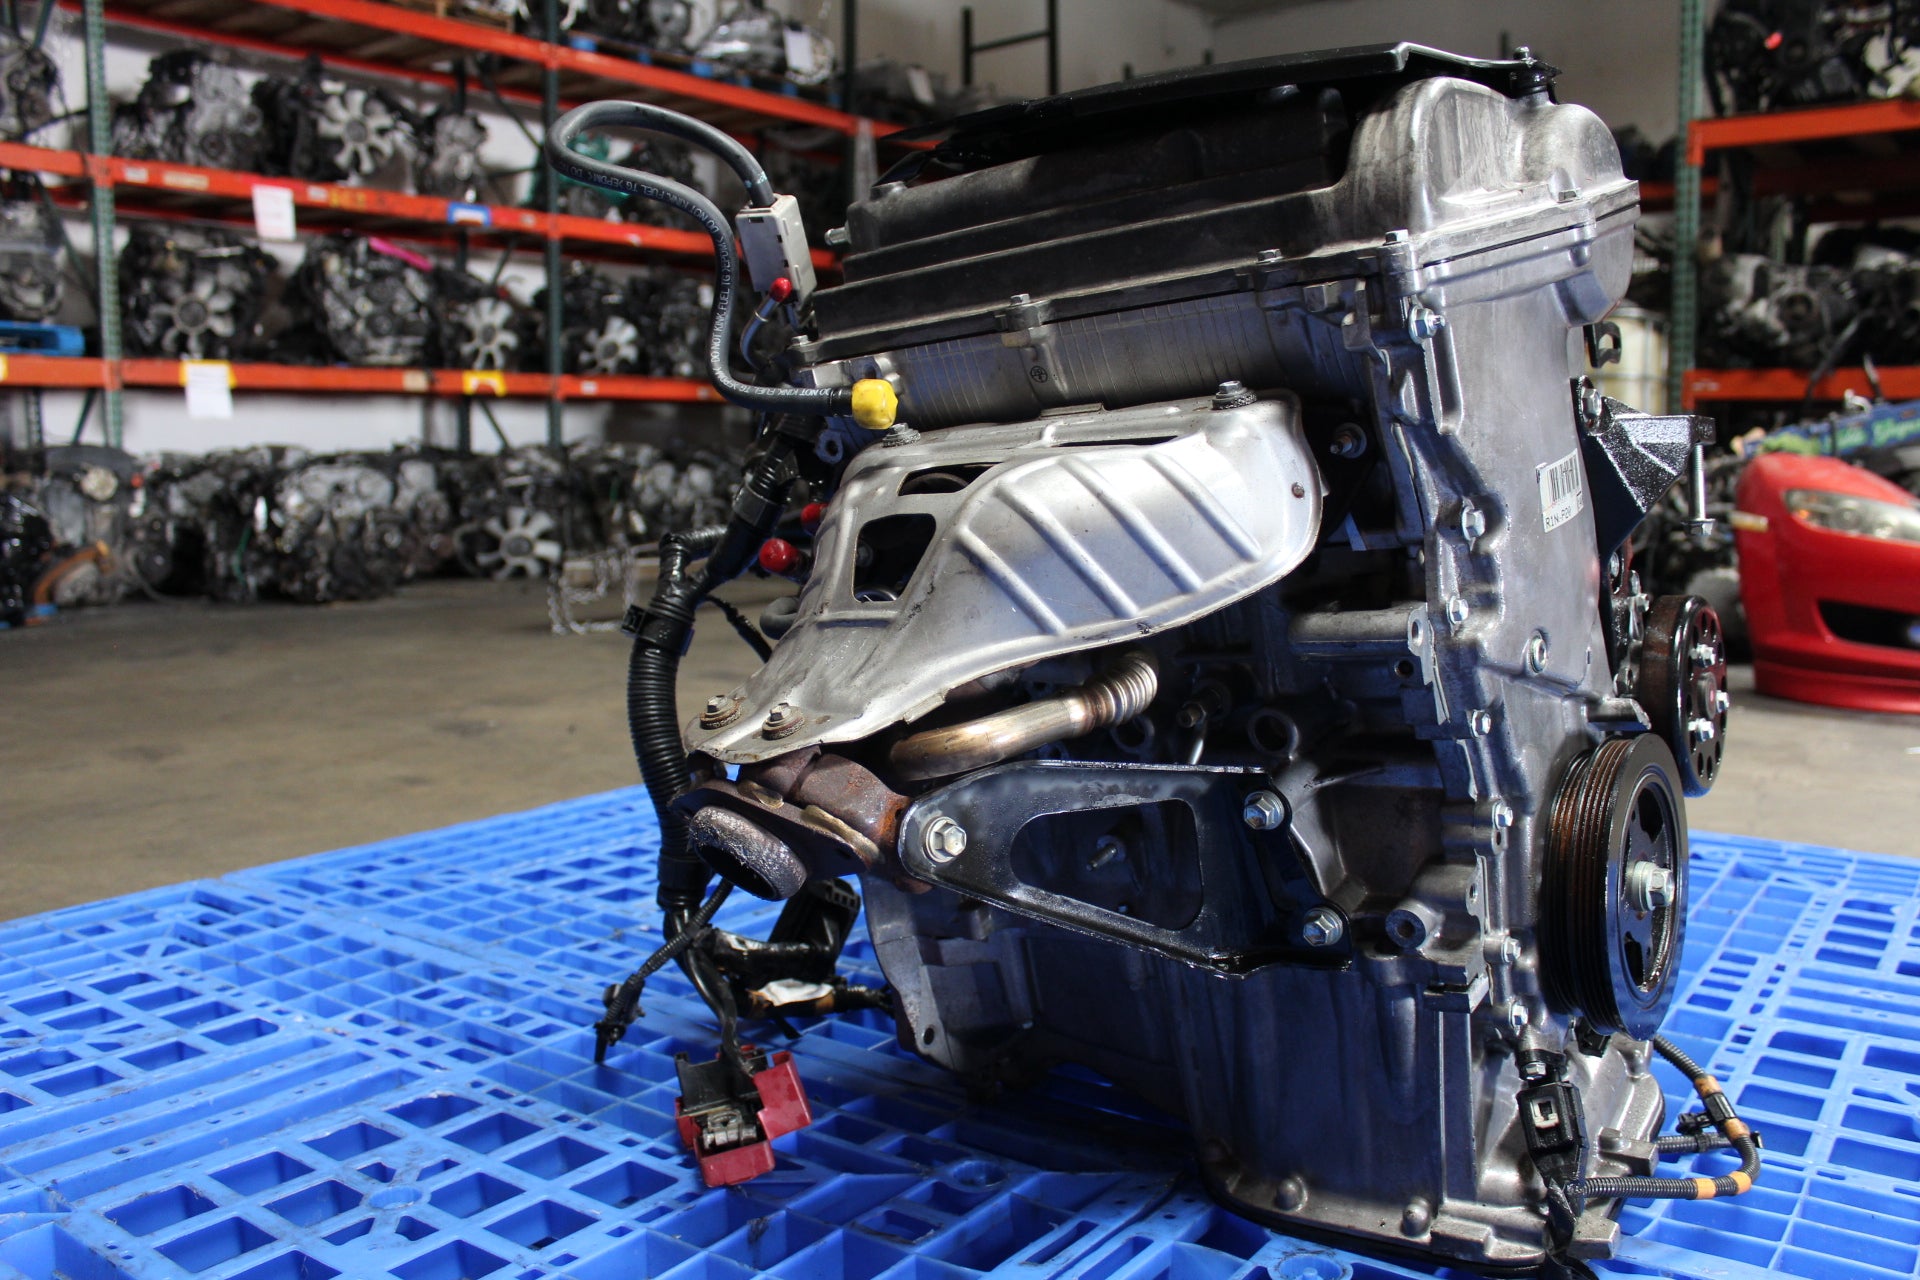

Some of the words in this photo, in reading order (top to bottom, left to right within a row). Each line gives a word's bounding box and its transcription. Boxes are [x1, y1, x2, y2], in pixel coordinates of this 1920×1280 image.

[625, 181, 638, 192] TG
[641, 184, 665, 200] FUEL
[706, 219, 720, 234] DO
[719, 288, 730, 311] FUEL
[711, 332, 722, 349] NOT
[710, 350, 721, 363] DO
[753, 386, 777, 396] FUEL
[799, 388, 819, 397] NOT
